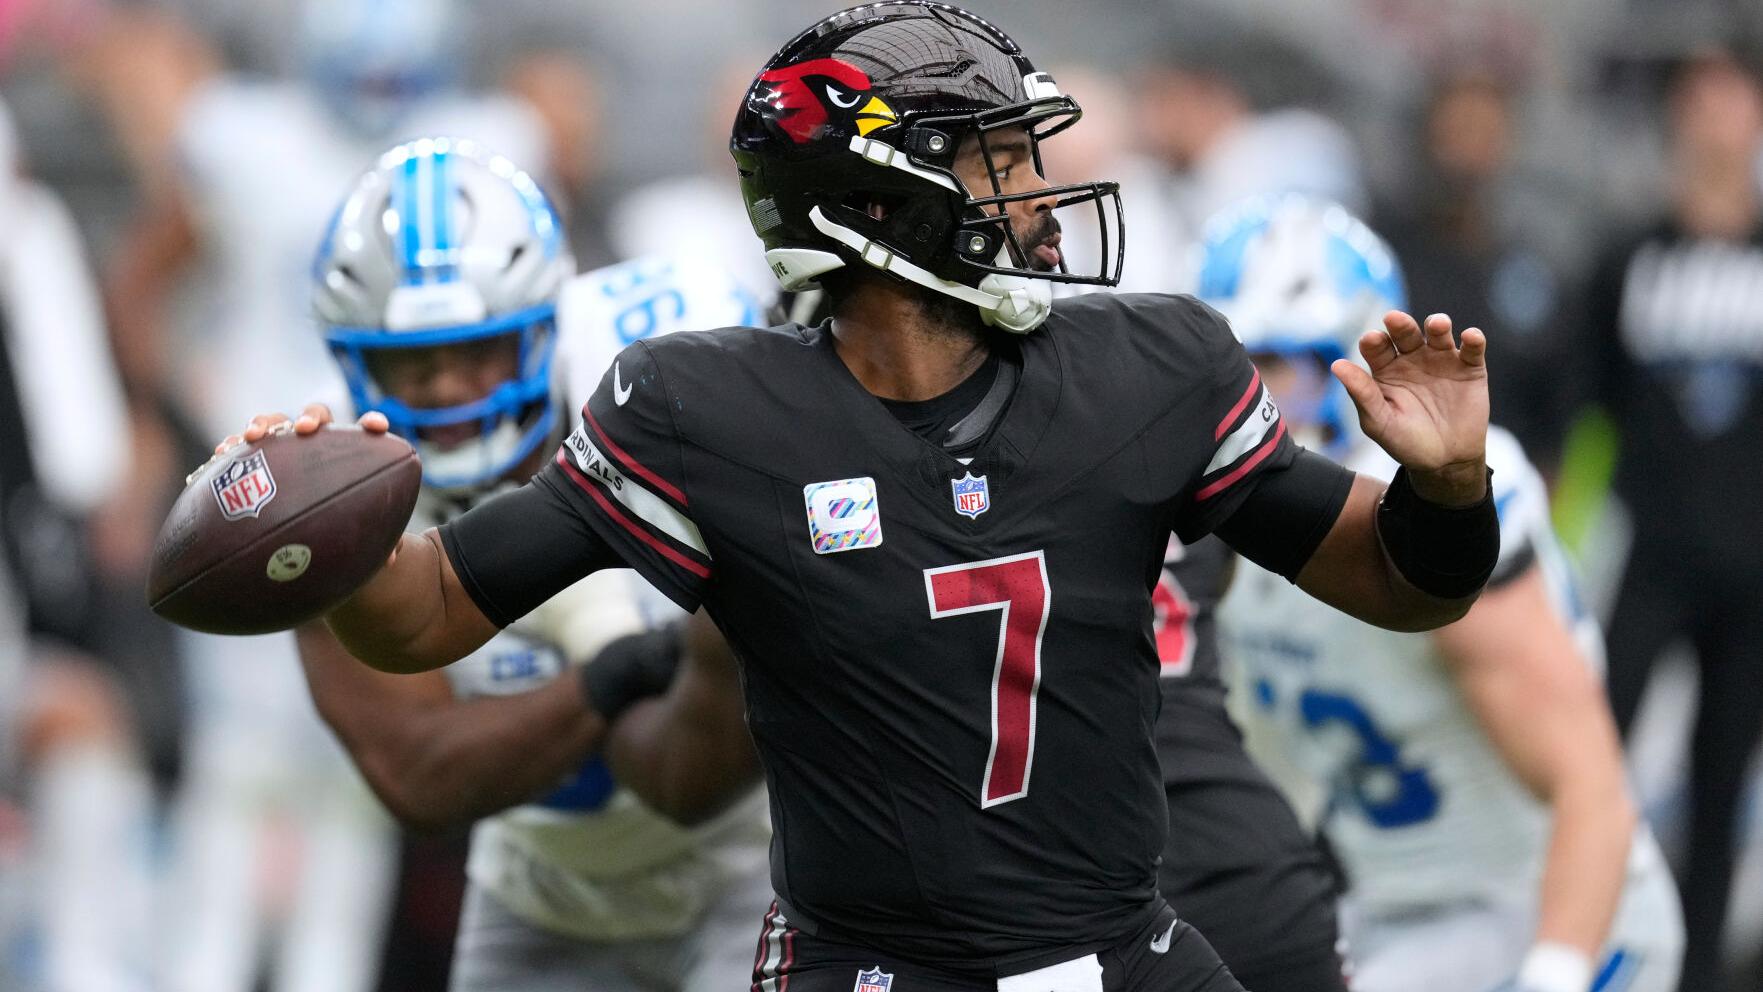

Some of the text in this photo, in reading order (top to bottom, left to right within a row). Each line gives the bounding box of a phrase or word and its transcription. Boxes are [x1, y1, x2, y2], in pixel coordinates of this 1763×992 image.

[1262, 393, 1276, 422] CA
[223, 472, 269, 512] NFL
[959, 493, 985, 511] NFL
[923, 550, 1051, 810] 7
